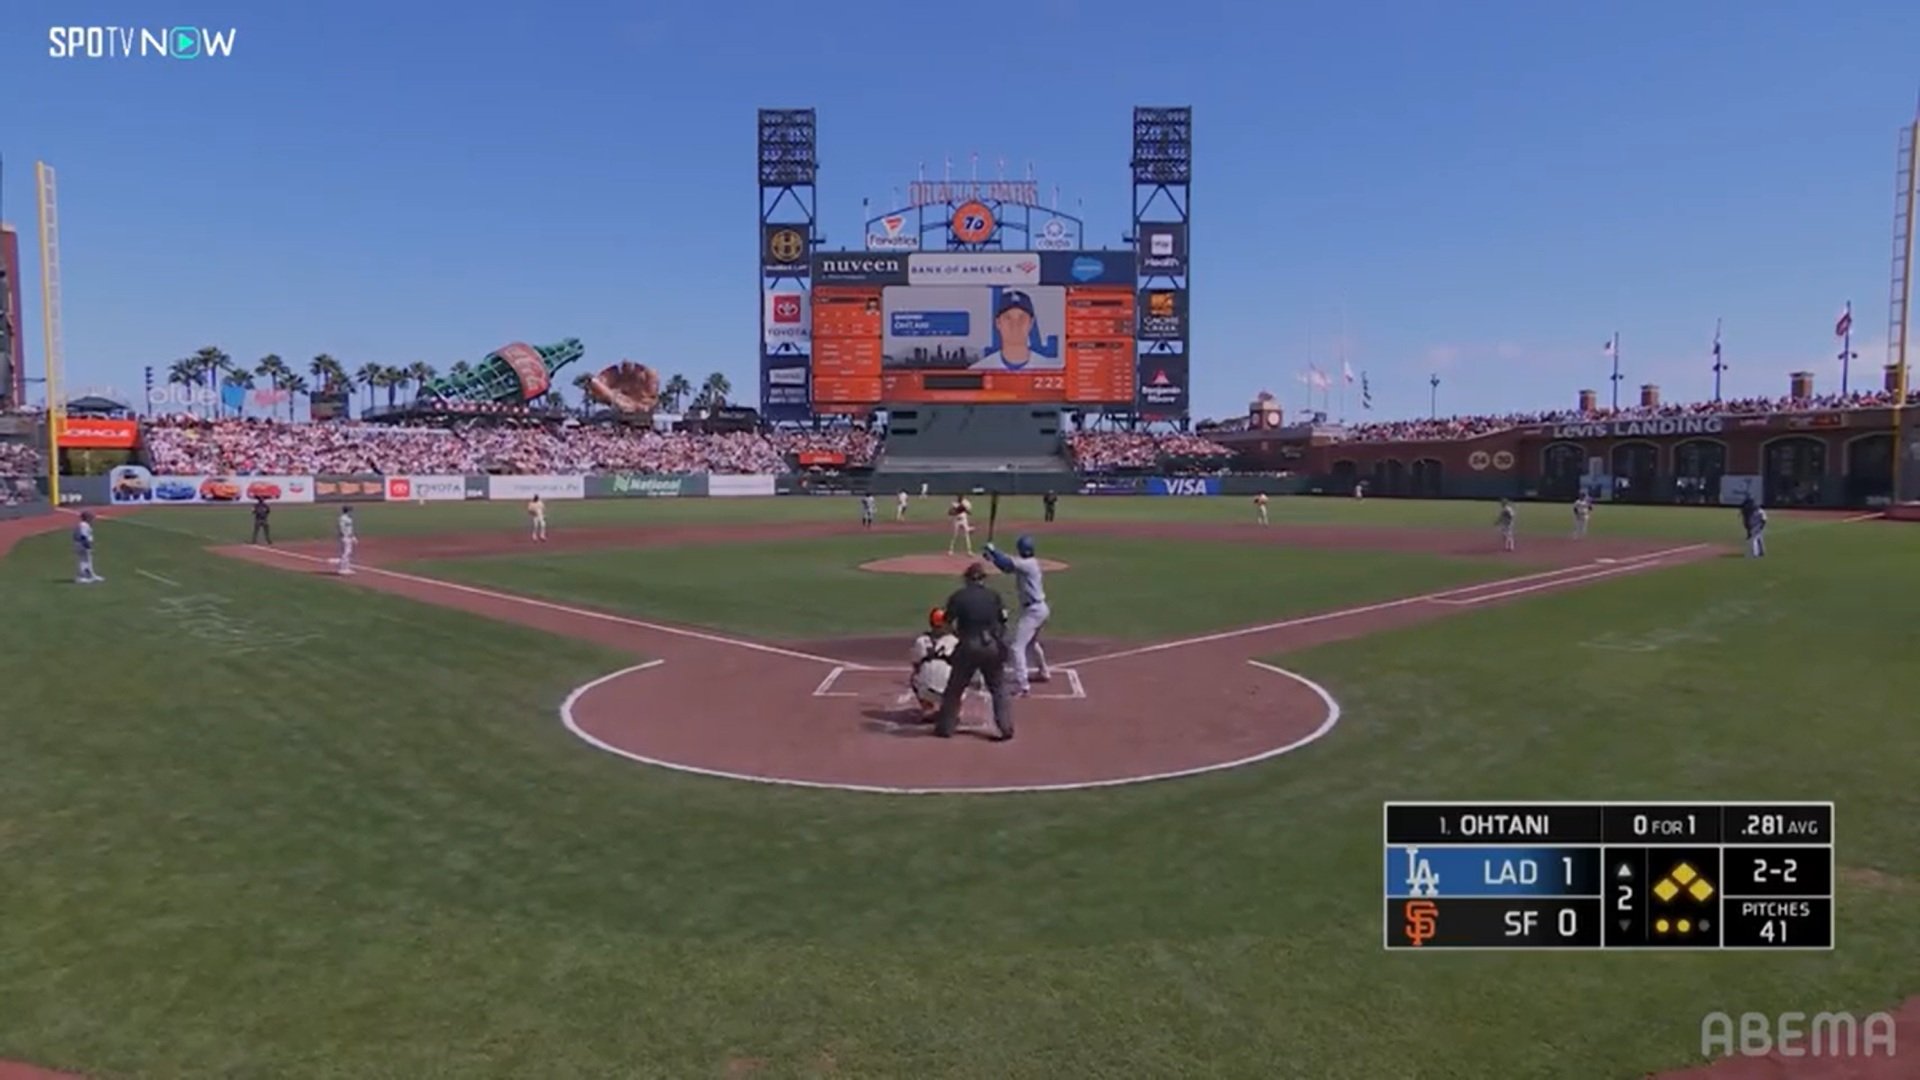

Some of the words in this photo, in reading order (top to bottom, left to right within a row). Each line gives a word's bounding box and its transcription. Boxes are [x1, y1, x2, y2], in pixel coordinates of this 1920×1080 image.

[823, 260, 899, 273] nuveen
[911, 265, 941, 275] BANK
[945, 265, 958, 275] OF
[962, 264, 1012, 275] AMERICA
[768, 328, 809, 337] TOYOTA
[1034, 377, 1065, 388] 222
[1614, 418, 1723, 437] LANDING
[1163, 479, 1207, 495] VISA
